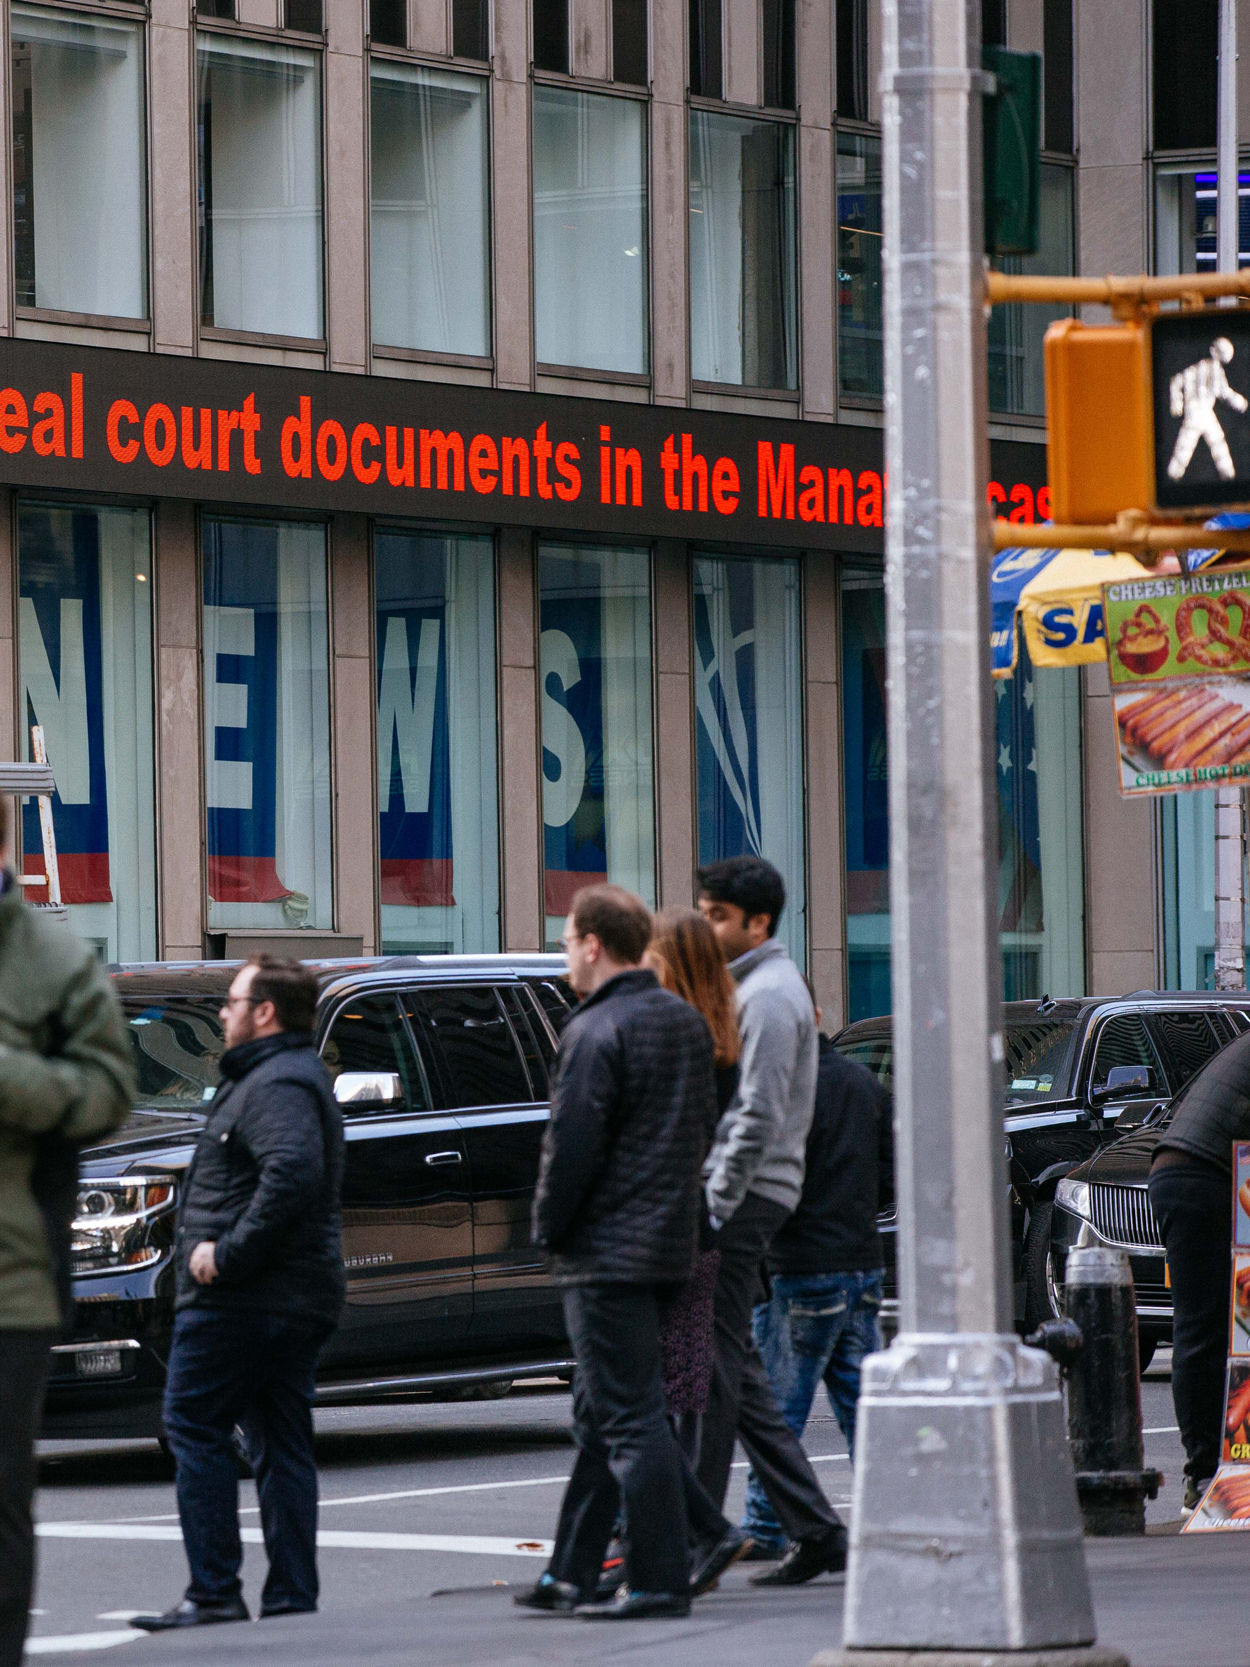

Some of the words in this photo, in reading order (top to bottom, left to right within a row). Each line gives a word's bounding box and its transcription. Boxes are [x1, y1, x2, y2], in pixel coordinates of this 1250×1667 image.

[106, 392, 262, 475] court
[280, 395, 582, 502] documents
[599, 424, 643, 507] in
[660, 433, 741, 516] the
[757, 440, 890, 529] Mana
[986, 480, 1055, 526] cas
[1108, 580, 1177, 602] CHEESE
[1135, 768, 1194, 787] CHEESE
[1197, 765, 1228, 782] HOT
[343, 1252, 393, 1268] UBURBAN
